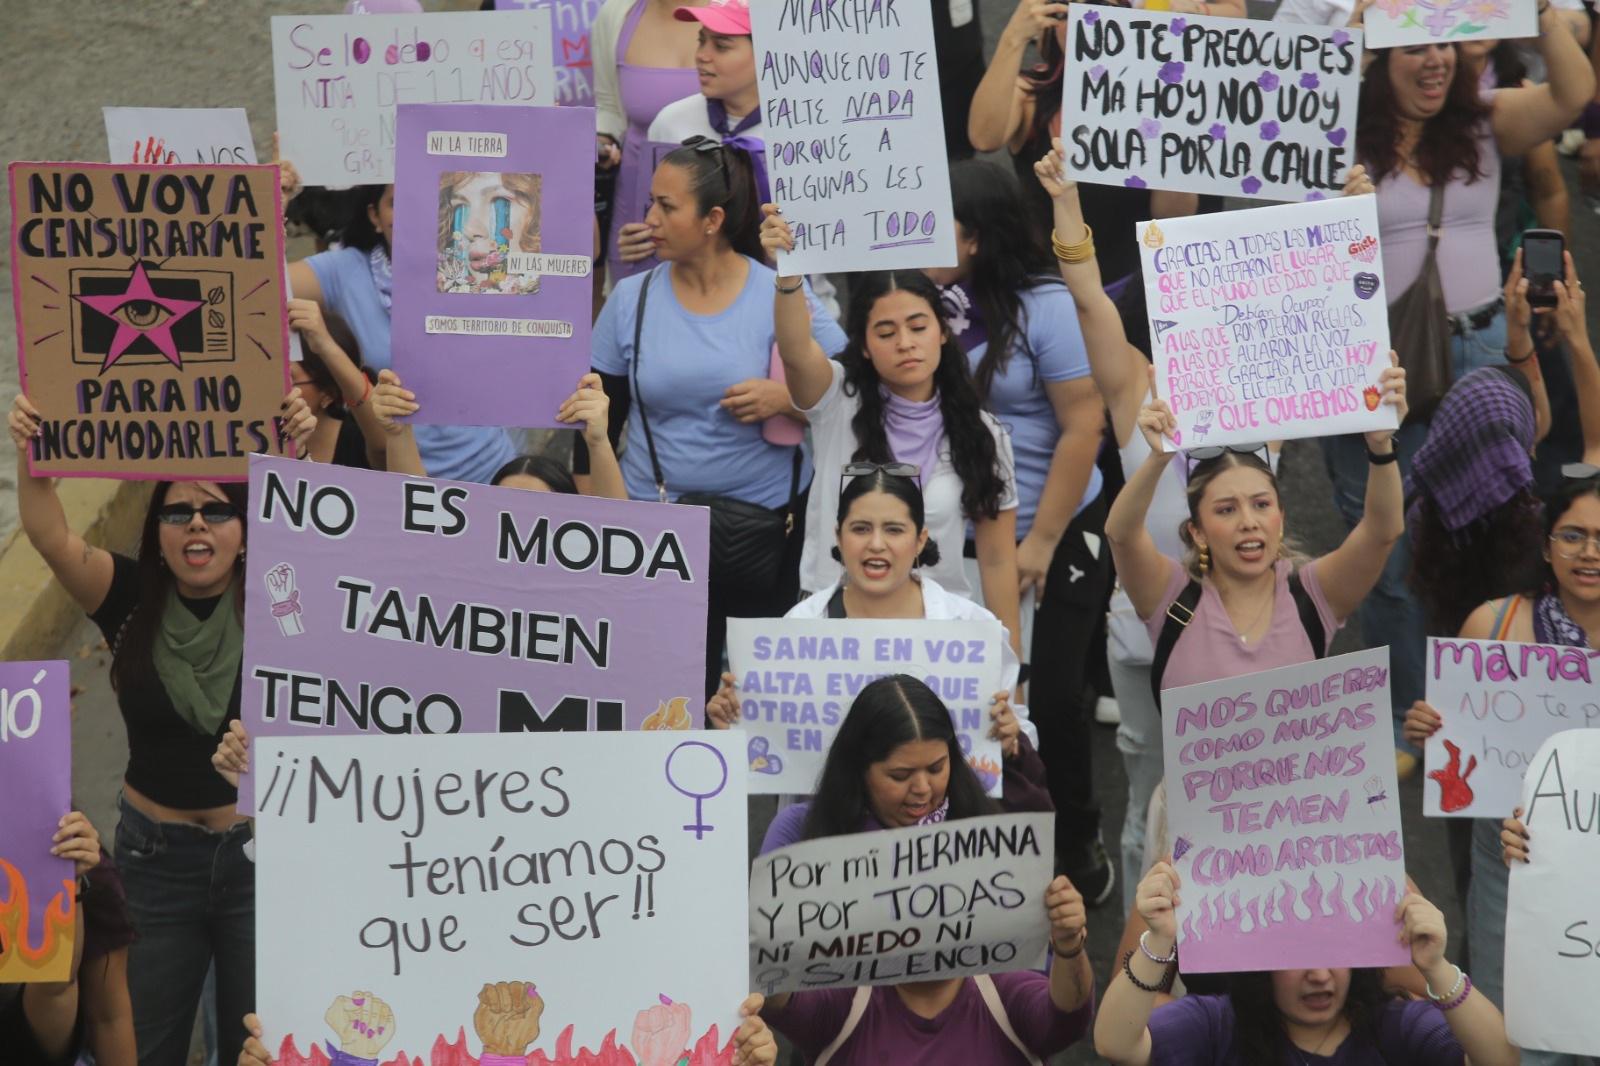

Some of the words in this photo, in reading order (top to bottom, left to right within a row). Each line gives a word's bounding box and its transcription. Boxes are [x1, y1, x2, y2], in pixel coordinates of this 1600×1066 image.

[288, 23, 333, 70] Se
[384, 26, 449, 65] debo
[1075, 19, 1125, 61] NO
[1129, 20, 1173, 62] TE
[1182, 24, 1355, 76] PREOCUPES
[480, 63, 536, 101] AÑOS
[762, 50, 851, 90] AUNQUE
[858, 53, 890, 81] NO
[900, 51, 927, 81] TE
[768, 98, 829, 129] FALTE
[842, 89, 914, 124] NADA
[1081, 66, 1126, 115] MÁ
[1136, 79, 1207, 126] HOY
[1216, 77, 1264, 126] NO
[431, 136, 443, 150] NI
[450, 137, 462, 152] LA
[469, 137, 503, 153] TIERRA
[773, 133, 851, 171] PORQUE
[879, 128, 891, 152] A
[1071, 124, 1147, 172] SOLA
[1160, 132, 1215, 180] POR
[1220, 137, 1252, 178] LA
[1262, 141, 1346, 190] CALLE
[30, 173, 93, 213] NO
[112, 174, 215, 215] VOY
[224, 174, 259, 217] A
[775, 168, 869, 202] ALGUNAS
[886, 164, 924, 190] LES
[18, 217, 265, 260] CENSURARME
[864, 210, 937, 250] TODO
[1153, 240, 1221, 274] GRACIAS
[1225, 239, 1239, 260] A
[1239, 231, 1281, 256] TODAS
[1283, 228, 1305, 249] LAS
[1306, 217, 1362, 248] MUJERES
[510, 260, 521, 274] NI
[526, 259, 542, 272] LAS
[547, 259, 587, 274] MUJERES
[1158, 271, 1187, 294] QUE
[1190, 267, 1211, 288] NO
[1213, 255, 1272, 286] ACEPTARON
[1273, 252, 1288, 274] EL
[1288, 243, 1340, 270] LUGAR
[1159, 290, 1189, 314] QUE
[1210, 279, 1258, 306] MUNDO
[1263, 275, 1281, 296] LES
[1283, 269, 1317, 292] DIJO
[1323, 260, 1353, 284] QUE
[429, 318, 458, 331] SOMOS
[462, 319, 508, 332] TERRITORIO
[511, 320, 522, 333] DE
[526, 321, 571, 334] CONQUISTA
[1165, 333, 1179, 354] A
[1179, 329, 1200, 350] LAS
[1201, 326, 1229, 347] QUE
[1232, 312, 1308, 343] ROMPIERON
[1167, 356, 1181, 375] A
[1182, 352, 1205, 371] LAS
[1207, 347, 1233, 369] QUE
[1303, 334, 1319, 353] LA
[1167, 368, 1222, 395] PORQUE
[1228, 358, 1289, 385] GRACIAS
[1292, 354, 1305, 375] A
[1305, 348, 1343, 372] ELLAS
[1345, 341, 1377, 367] HOY
[76, 378, 187, 414] PARA
[195, 374, 242, 413] NO
[1169, 384, 1236, 415] PODEMOS
[1242, 376, 1296, 400] ELEGIR
[1304, 373, 1323, 391] LA
[1327, 364, 1369, 387] VIDA
[1217, 400, 1259, 431] QUE
[1264, 385, 1360, 425] QUEREMOS
[262, 472, 355, 536] NO
[404, 482, 468, 535] ES
[498, 512, 691, 581] MODA
[337, 580, 609, 668] TAMBIEN
[753, 636, 860, 661] SANAR
[874, 638, 912, 661] EN
[924, 640, 985, 663] VOZ
[255, 669, 462, 734] TENGO
[743, 671, 813, 696] ALTA
[1175, 691, 1257, 736] NOS
[1265, 665, 1388, 717] QUIEREN
[1461, 690, 1525, 722] NO
[1537, 694, 1570, 720] te
[743, 700, 841, 725] OTRAS
[1179, 728, 1265, 765] COMO
[1273, 703, 1376, 744] MUSAS
[787, 729, 822, 751] EN
[1183, 753, 1301, 802] PORQUE
[1304, 742, 1366, 780] NOS
[1208, 789, 1349, 834] TEMEN
[389, 835, 666, 898] teníamos
[892, 825, 1040, 878] HERMANA
[1192, 844, 1273, 886] COMO
[1275, 830, 1402, 871] ARTISTAS
[757, 902, 783, 939] Y
[873, 871, 1025, 920] TODAS
[360, 914, 466, 976] que
[801, 942, 1017, 986] SILENCIO
[808, 927, 921, 960] MIEDO
